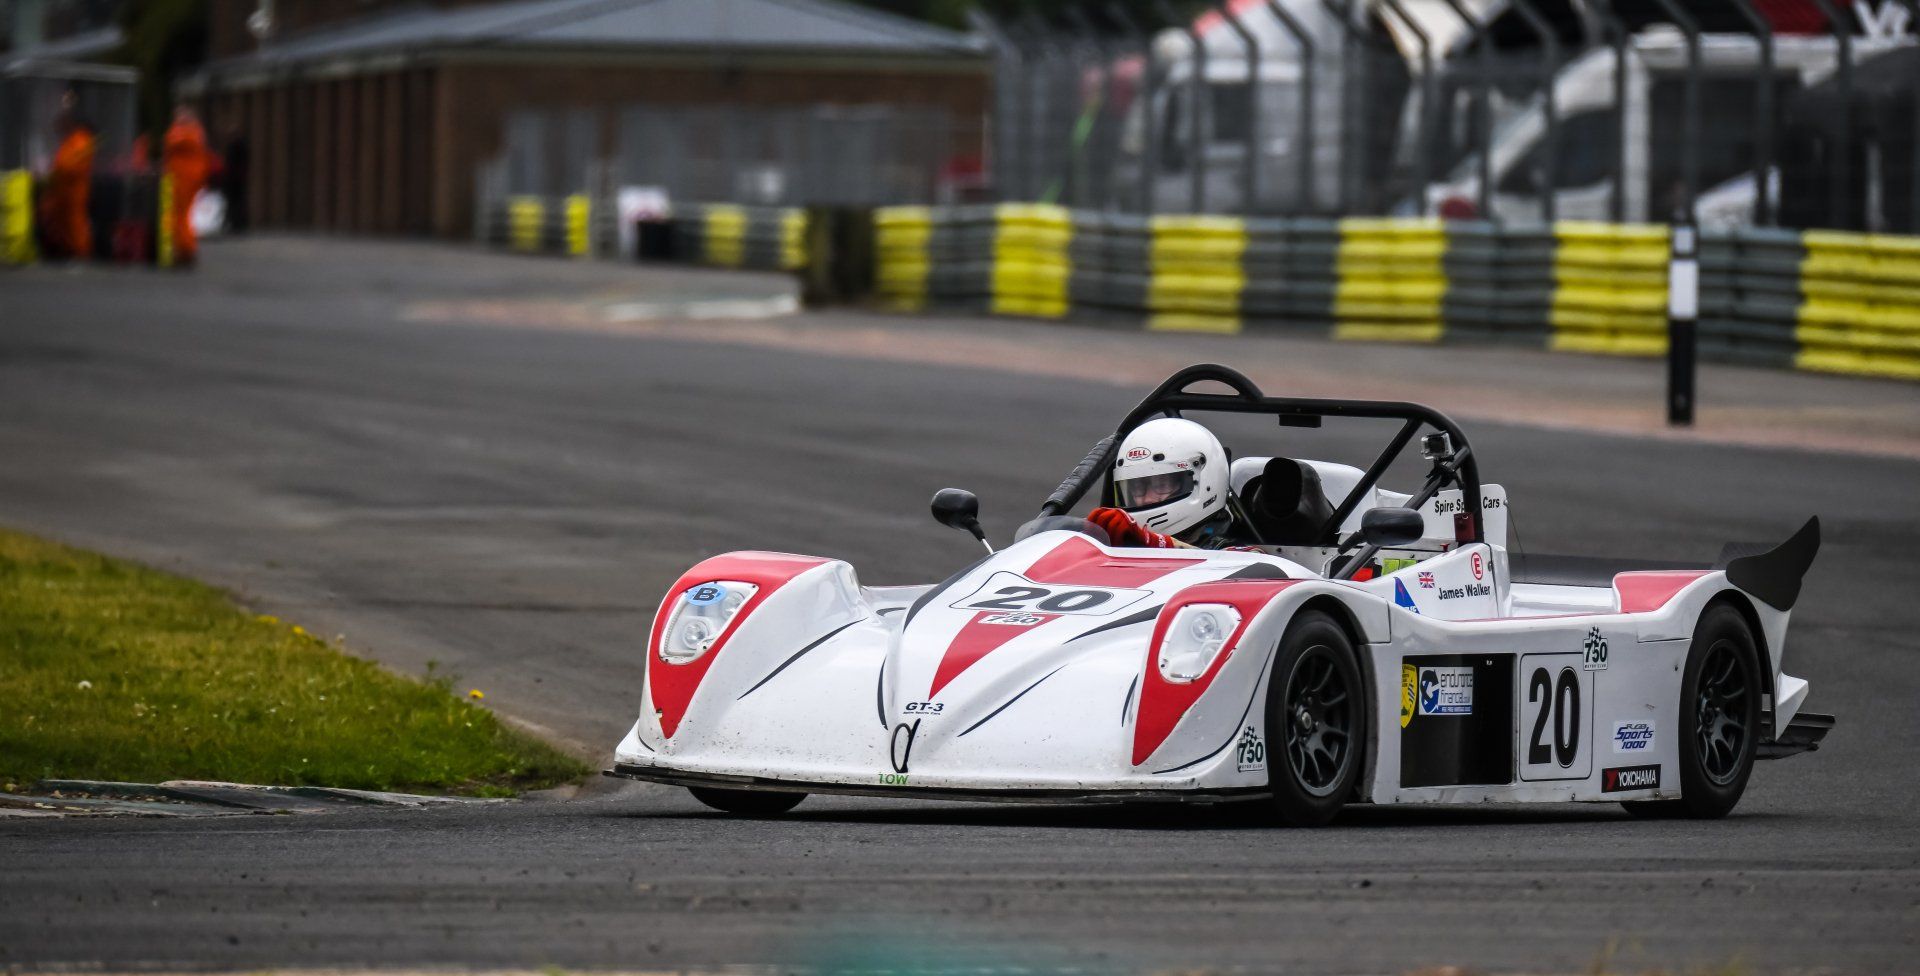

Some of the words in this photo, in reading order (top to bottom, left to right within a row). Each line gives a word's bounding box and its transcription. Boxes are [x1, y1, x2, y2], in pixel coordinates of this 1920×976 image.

[1434, 500, 1454, 516] Spire
[1482, 496, 1500, 509] Cars
[1474, 558, 1481, 574] E
[693, 587, 718, 601] B
[967, 586, 1115, 612] 20
[1438, 587, 1464, 600] James
[1465, 584, 1490, 597] Walker
[1584, 642, 1607, 663] 750
[905, 702, 944, 711] GT-3
[1528, 666, 1580, 768] 20
[1614, 727, 1654, 742] Sports
[1238, 742, 1263, 763] 750
[1622, 741, 1647, 749] 1000
[879, 773, 909, 784] TOW
[1618, 769, 1656, 787] YOKOHAMA
